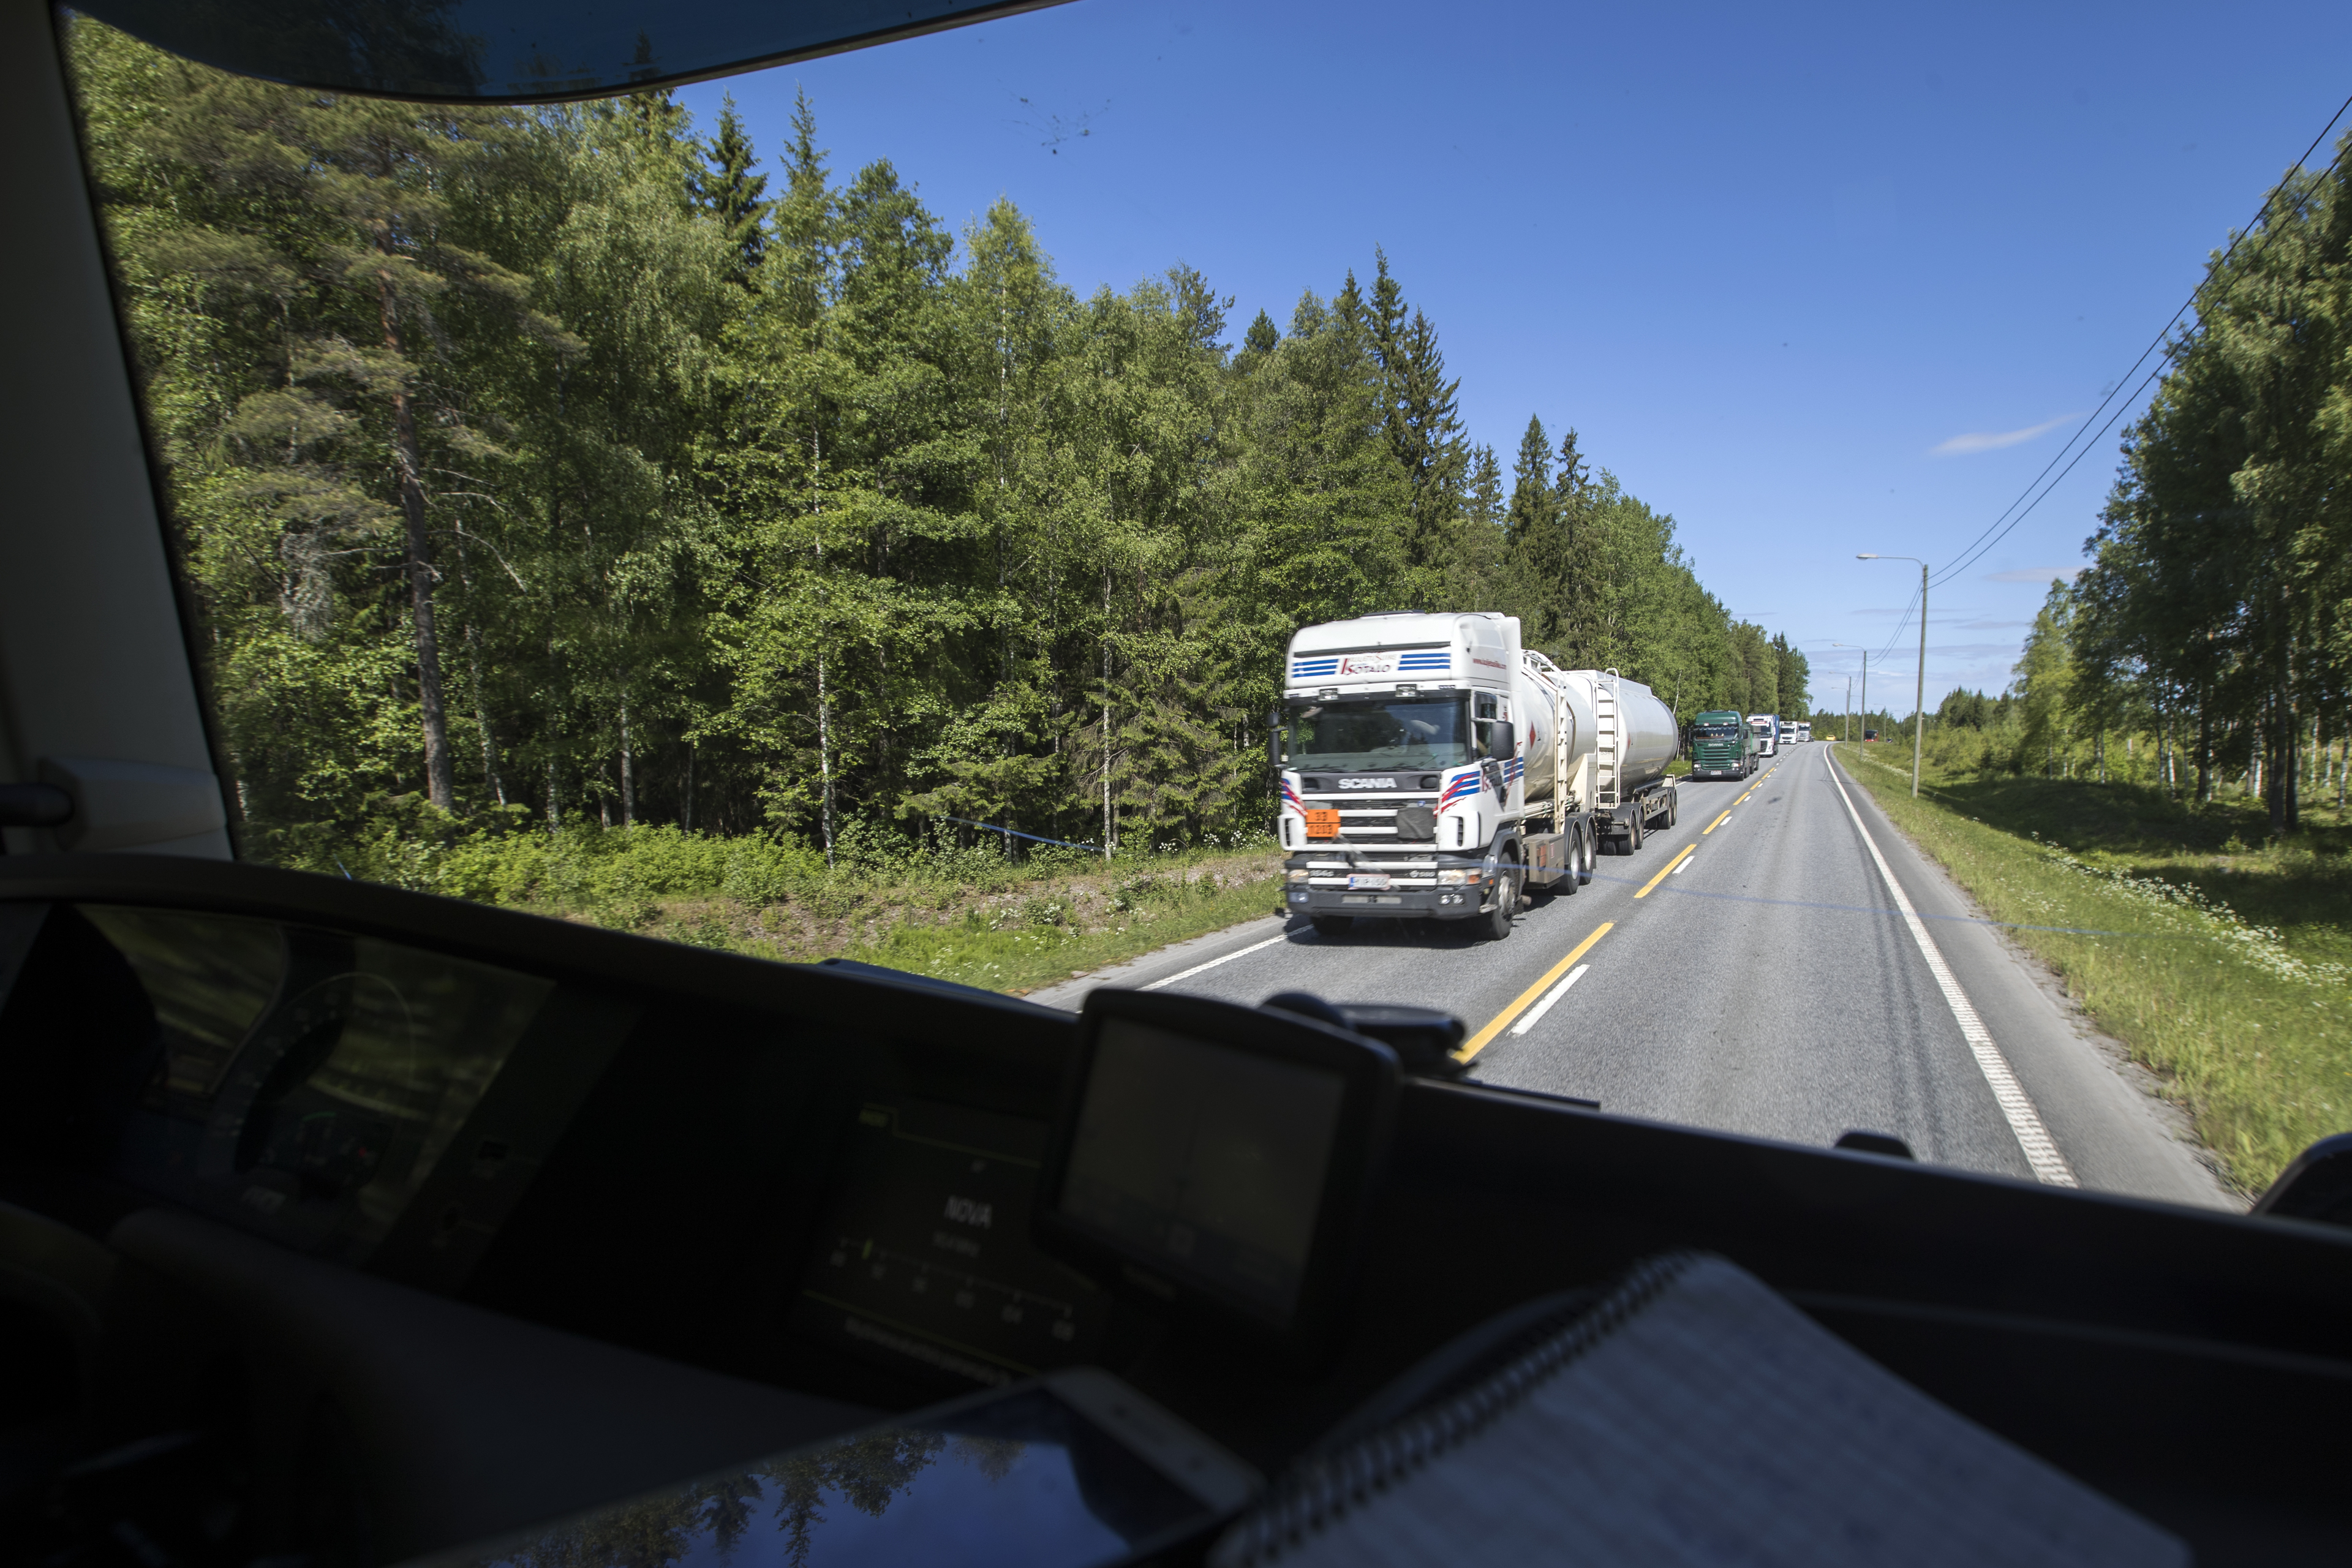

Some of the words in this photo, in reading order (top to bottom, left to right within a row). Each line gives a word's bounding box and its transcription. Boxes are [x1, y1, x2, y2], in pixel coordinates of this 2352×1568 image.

[1338, 777, 1398, 789] SCANIA
[1315, 812, 1328, 821] 33
[944, 1195, 993, 1229] NOVA
